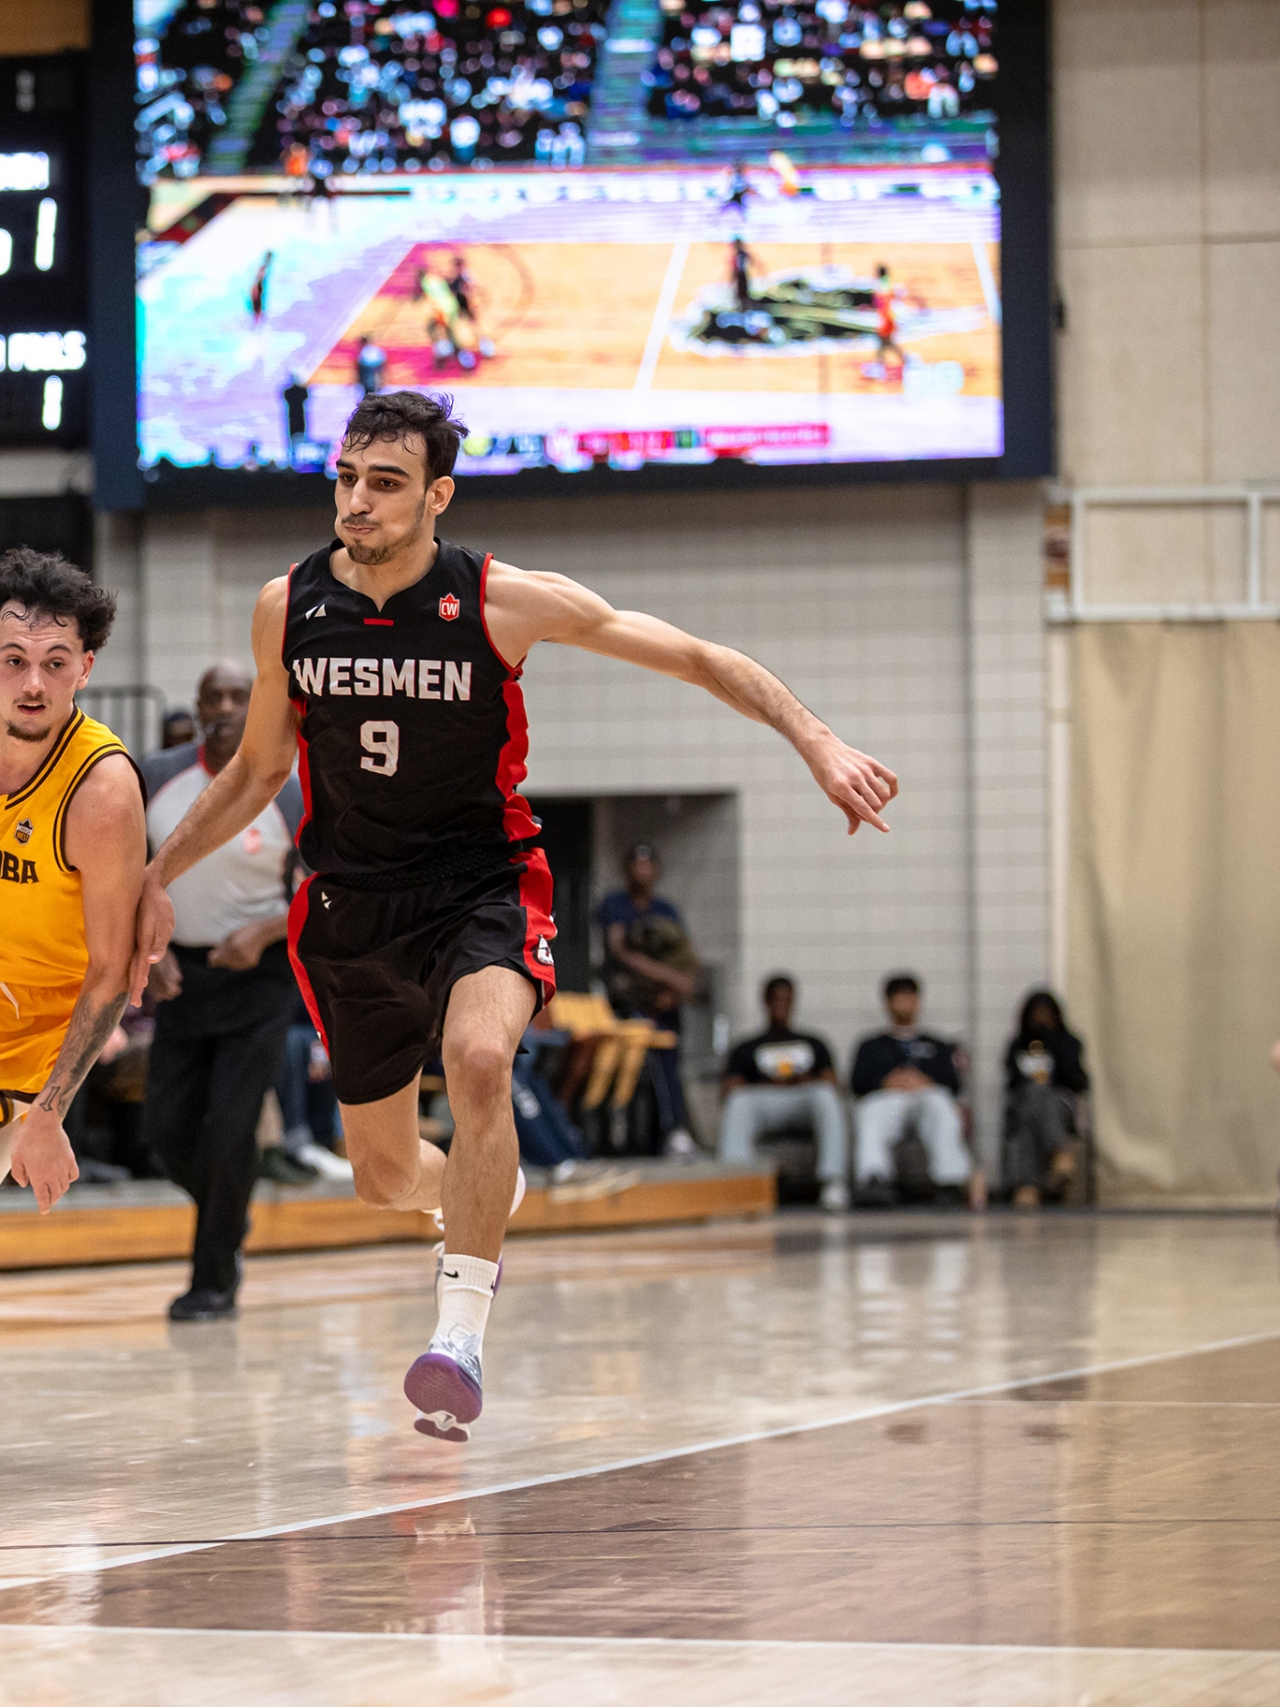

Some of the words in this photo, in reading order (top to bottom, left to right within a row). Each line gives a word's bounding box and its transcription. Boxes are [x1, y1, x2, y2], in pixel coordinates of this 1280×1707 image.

[441, 603, 458, 616] CW
[293, 657, 472, 701] WESMEN
[360, 720, 400, 777] 9
